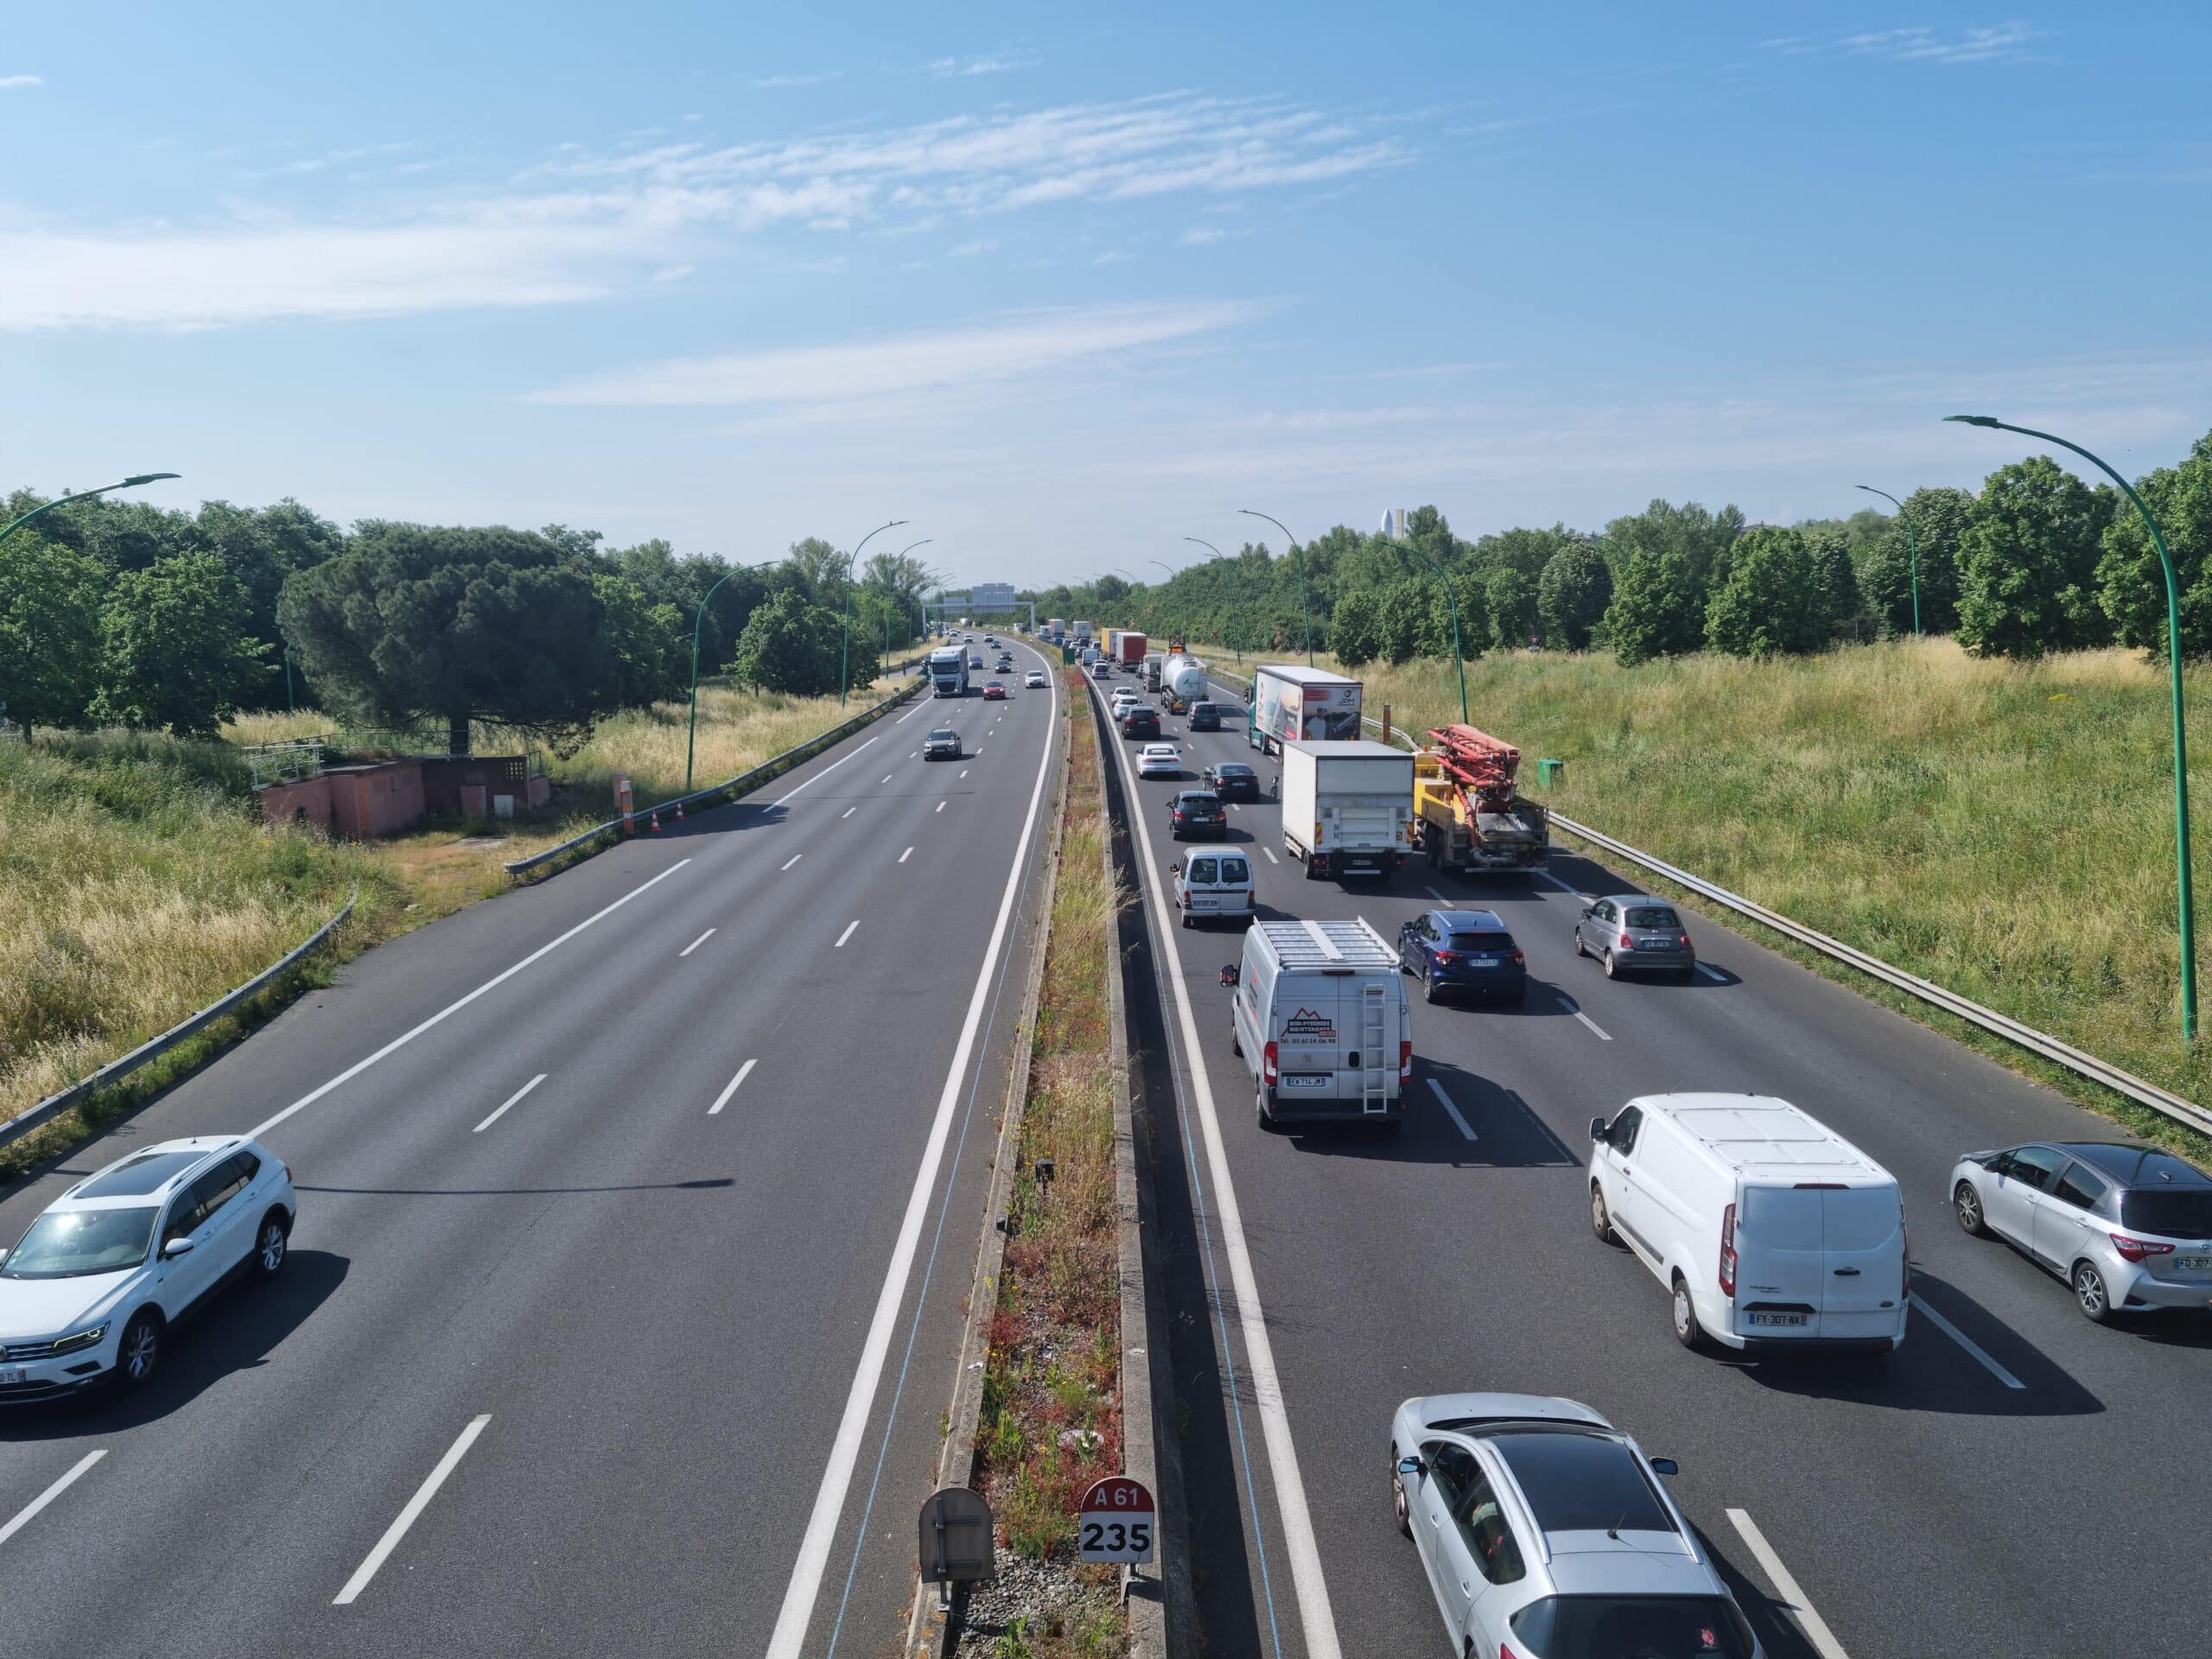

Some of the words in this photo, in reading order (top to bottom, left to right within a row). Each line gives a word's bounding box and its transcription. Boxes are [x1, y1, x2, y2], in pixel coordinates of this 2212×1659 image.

[1095, 1487, 1108, 1505] A
[1114, 1487, 1138, 1506] 61
[1083, 1523, 1150, 1552] 235
